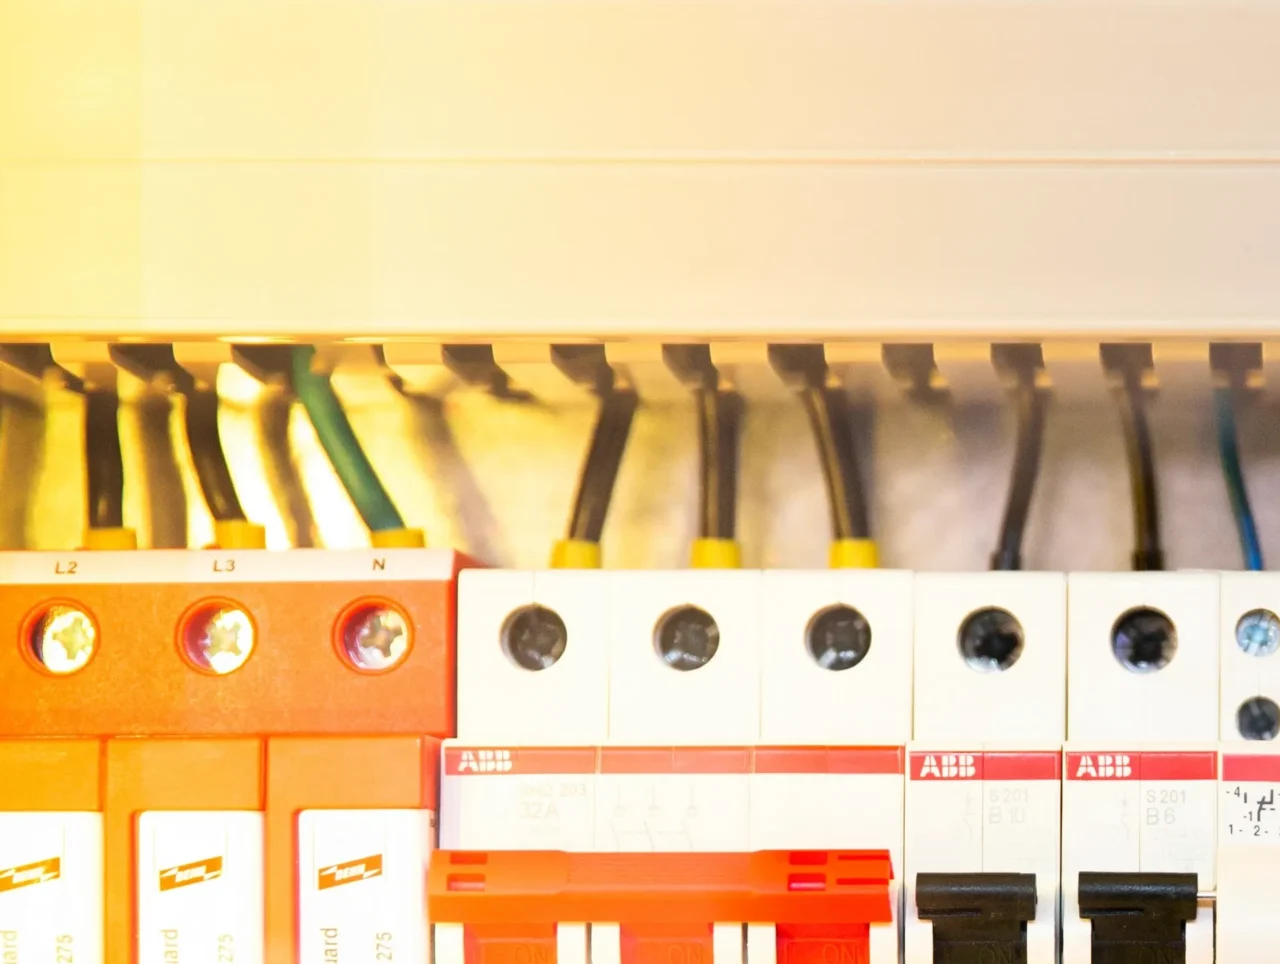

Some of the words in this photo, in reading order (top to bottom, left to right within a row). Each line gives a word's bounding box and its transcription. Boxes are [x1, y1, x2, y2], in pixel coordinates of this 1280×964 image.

[54, 560, 78, 575] L2
[212, 559, 236, 573] L3
[372, 558, 386, 572] N
[458, 750, 513, 772] ABB
[920, 755, 976, 778] ABB
[1076, 755, 1132, 778] ABB
[56, 934, 73, 964] 275
[217, 933, 234, 963] 275
[375, 932, 393, 961] 275
[822, 942, 858, 964] ON
